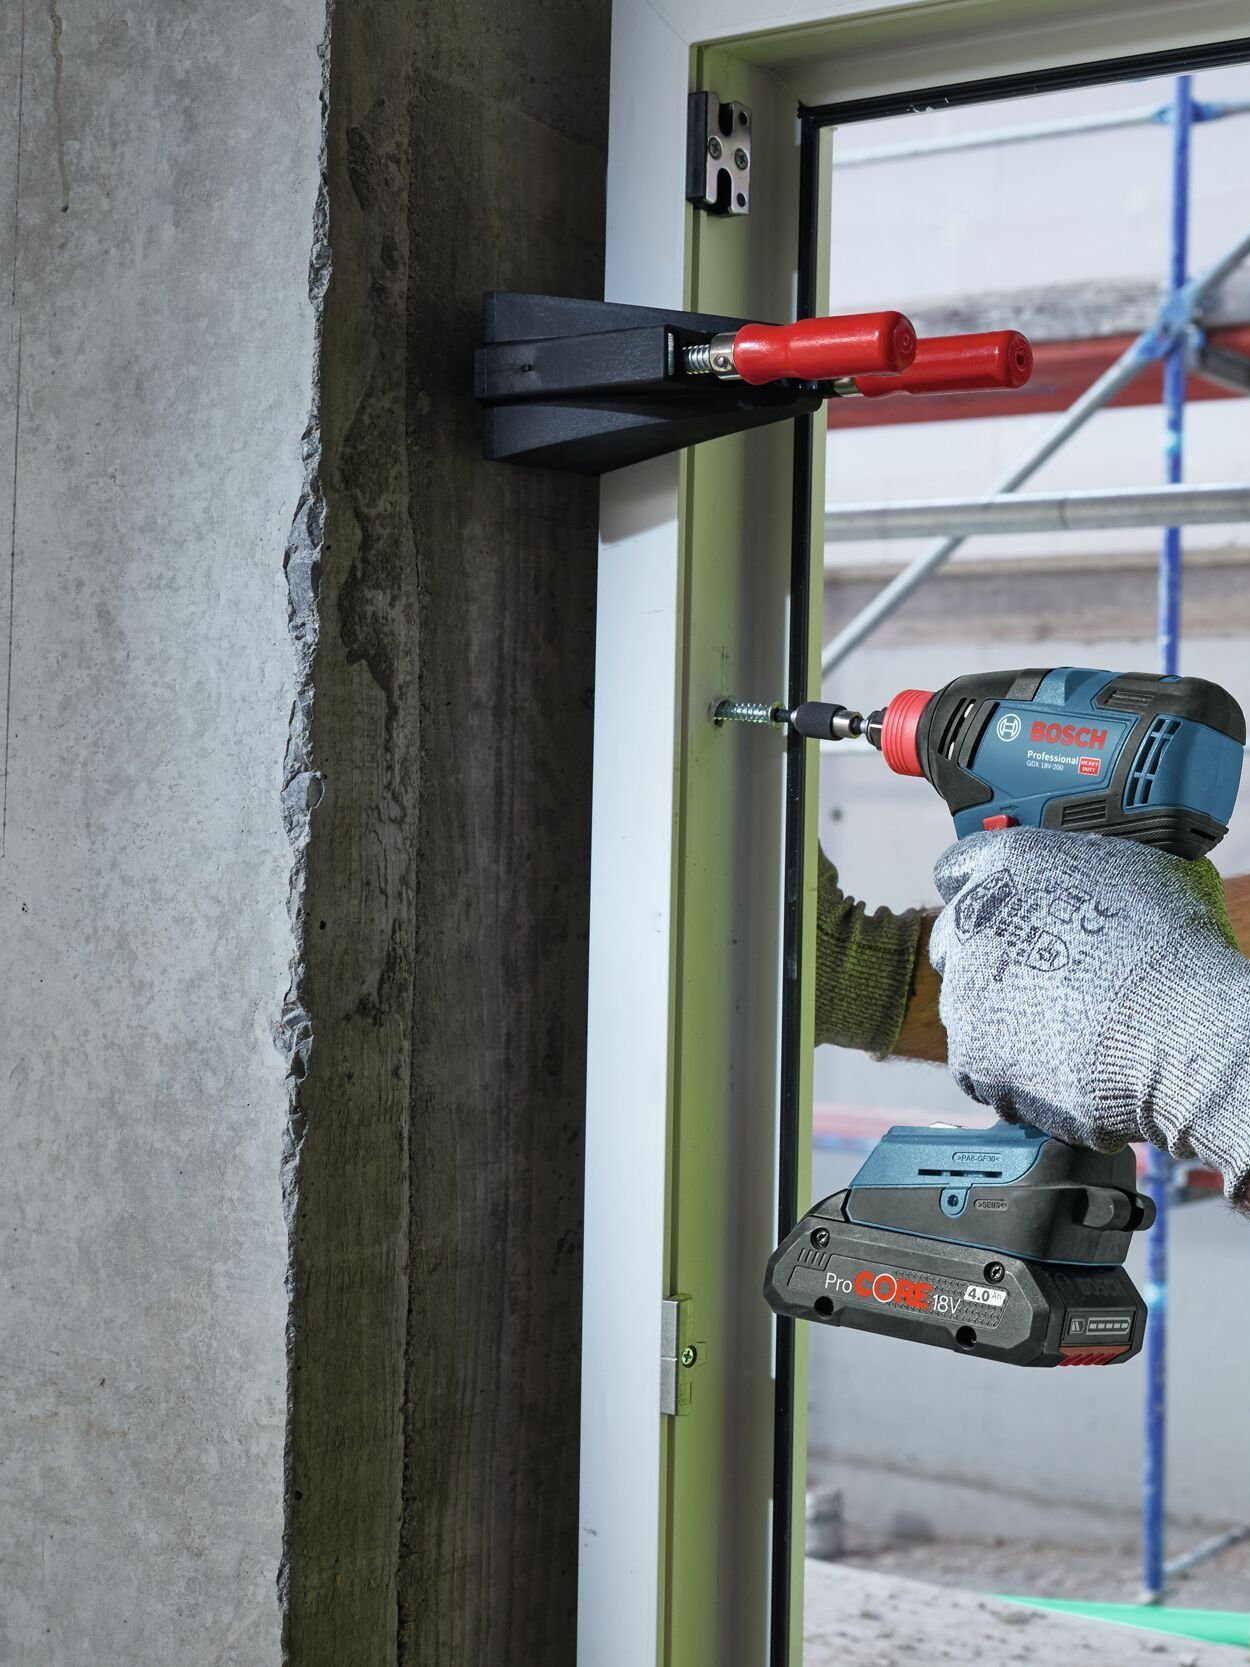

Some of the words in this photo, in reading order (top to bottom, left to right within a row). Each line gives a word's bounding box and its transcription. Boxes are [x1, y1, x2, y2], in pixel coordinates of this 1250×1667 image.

[1030, 721, 1108, 750] BOSCH
[1026, 760, 1040, 768] GDX
[1027, 750, 1079, 765] Professional
[967, 1287, 990, 1302] 4.0
[991, 1291, 1002, 1300] Ah
